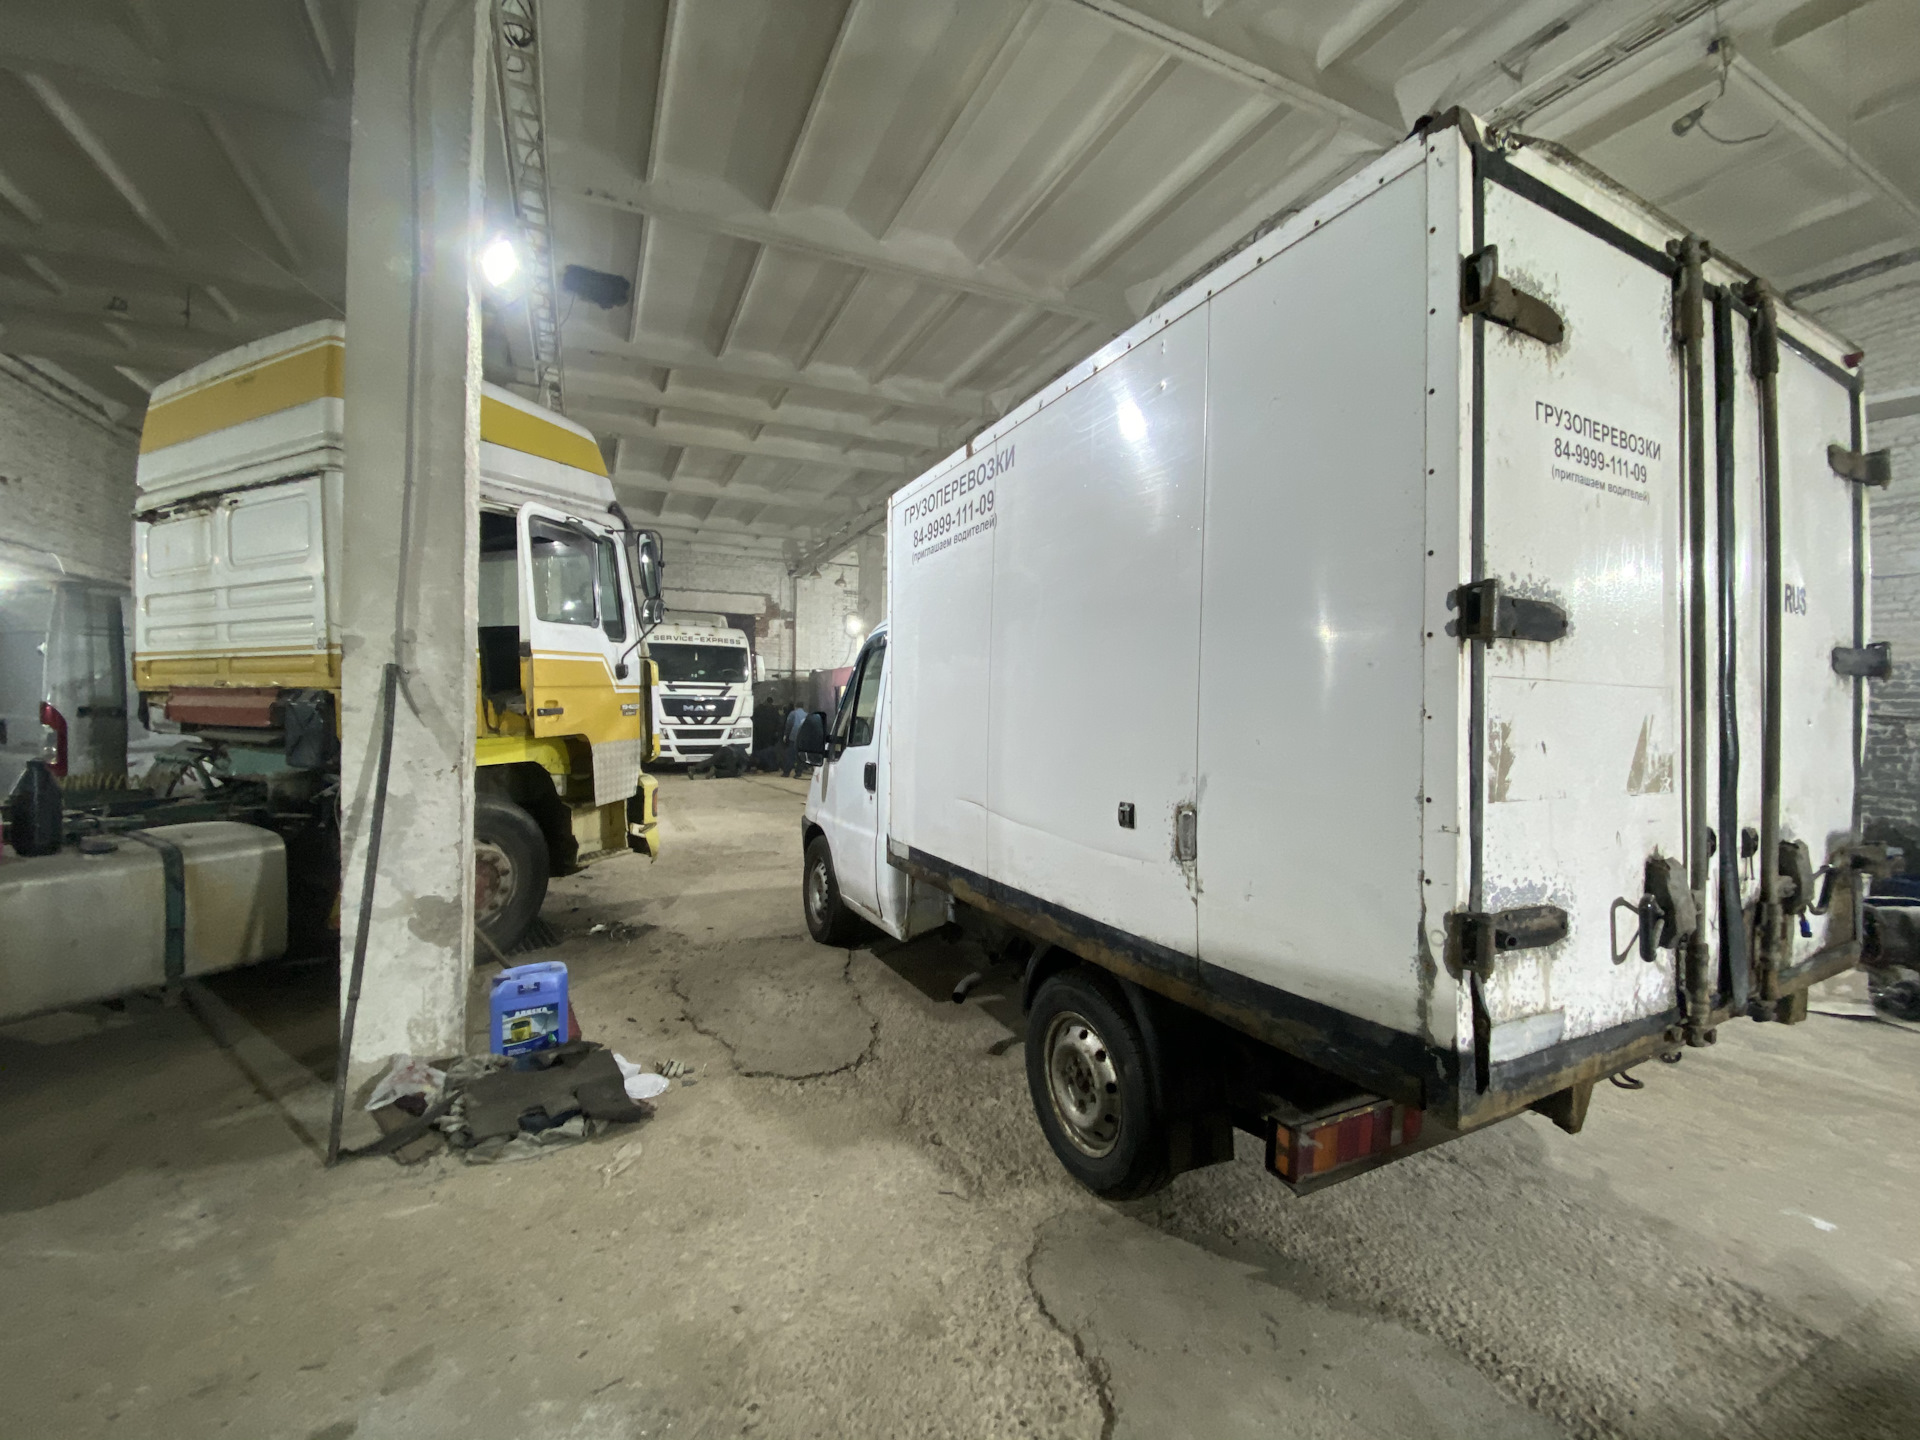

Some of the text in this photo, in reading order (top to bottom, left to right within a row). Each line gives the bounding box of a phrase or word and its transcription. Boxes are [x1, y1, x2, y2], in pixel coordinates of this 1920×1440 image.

[1535, 400, 1661, 461] ГРУЗОПЕРЕВОЗКИ
[904, 444, 1015, 526] ГРУЗОПЕРЕВОЗКИ
[1551, 464, 1651, 505] (приглашаем водителей)
[1554, 437, 1647, 483] 84-9999-111-09
[911, 512, 998, 566] (приглашаем водителей)
[913, 490, 995, 548] 84-9999-111-09
[1784, 583, 1807, 616] RUS
